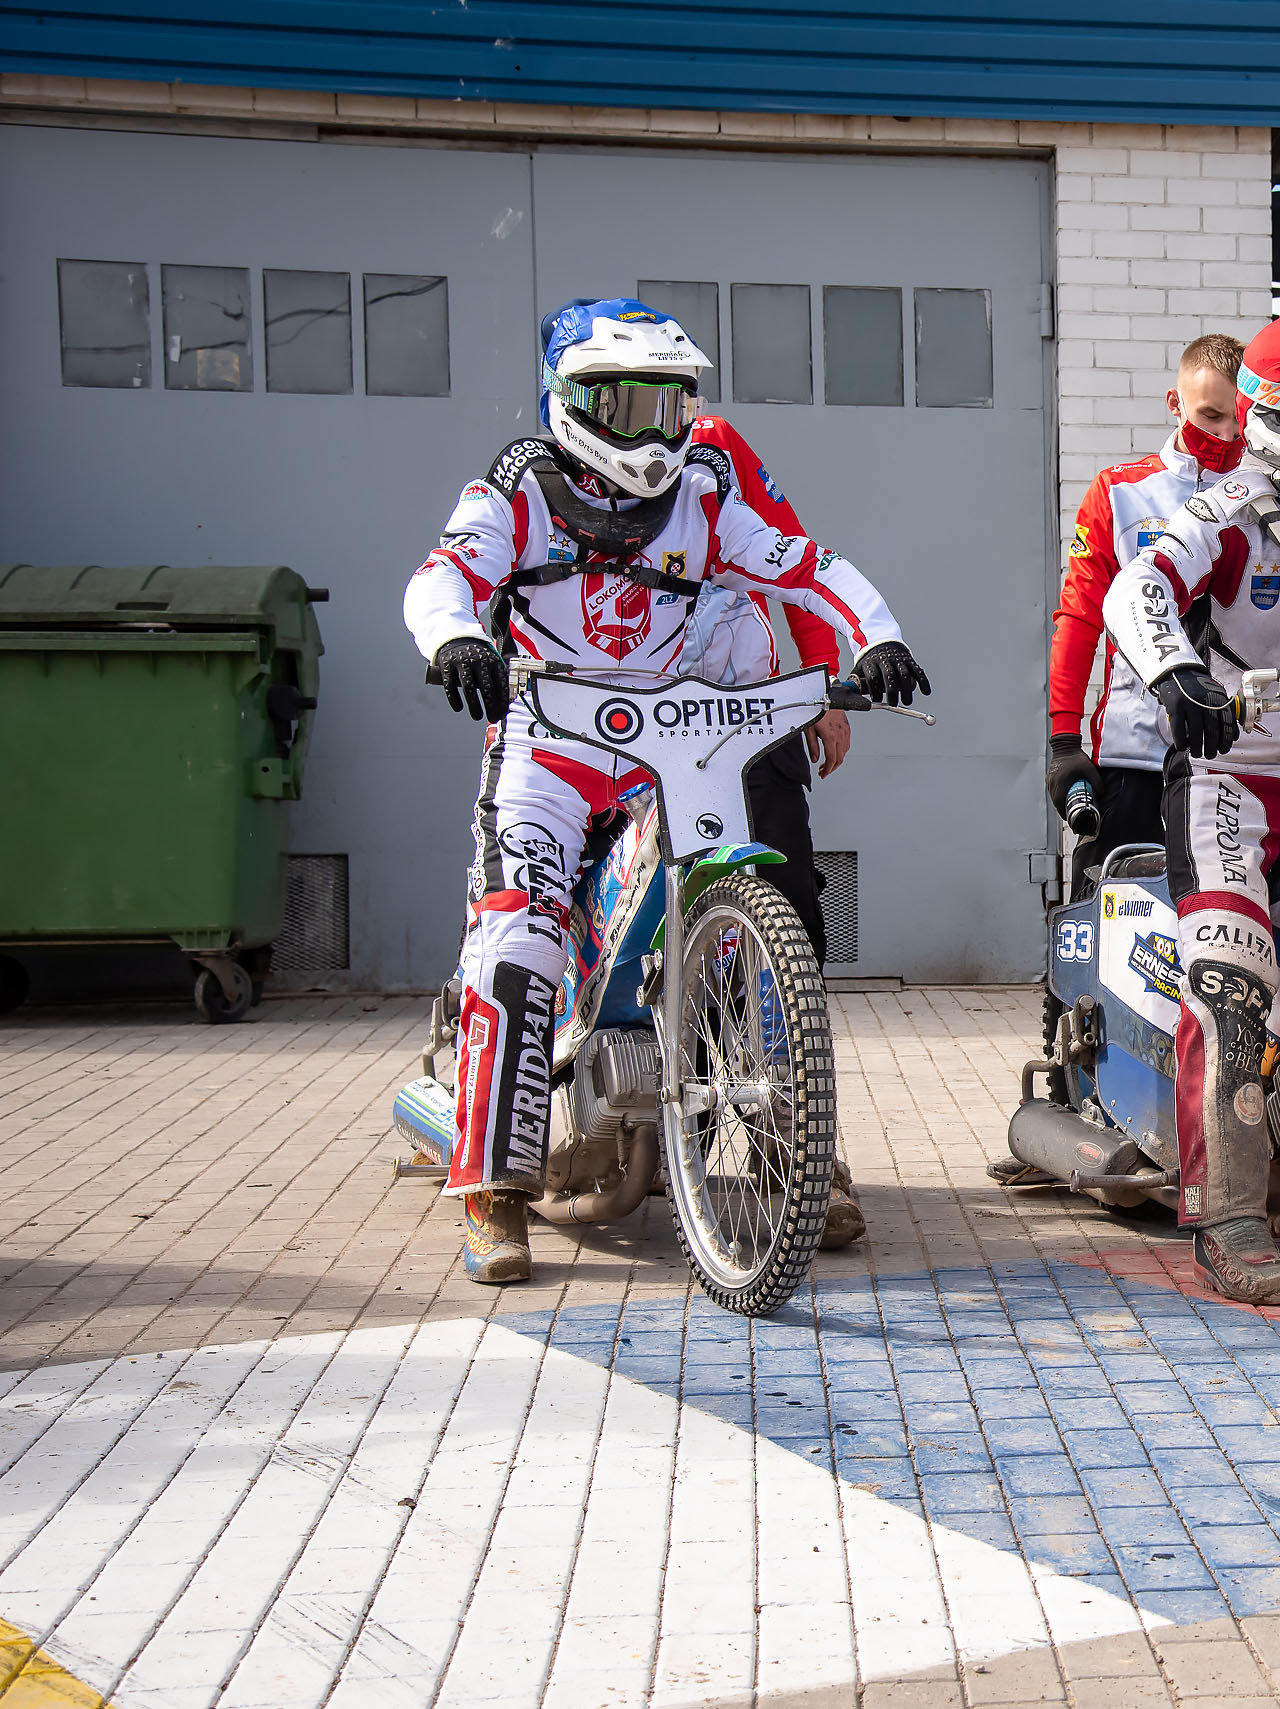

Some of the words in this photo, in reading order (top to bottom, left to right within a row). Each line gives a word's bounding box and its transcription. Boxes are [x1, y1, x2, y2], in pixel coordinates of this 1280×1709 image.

[493, 440, 548, 485] HAGON
[503, 448, 555, 491] SHOCKS
[653, 698, 775, 728] OPTIBET
[658, 728, 723, 738] SPORTA
[736, 726, 775, 737] BĀRS
[1057, 919, 1095, 963] 33
[1131, 943, 1184, 985] ERNES
[1153, 977, 1182, 1000] RACIN
[506, 974, 554, 1182] MERIDIAN
